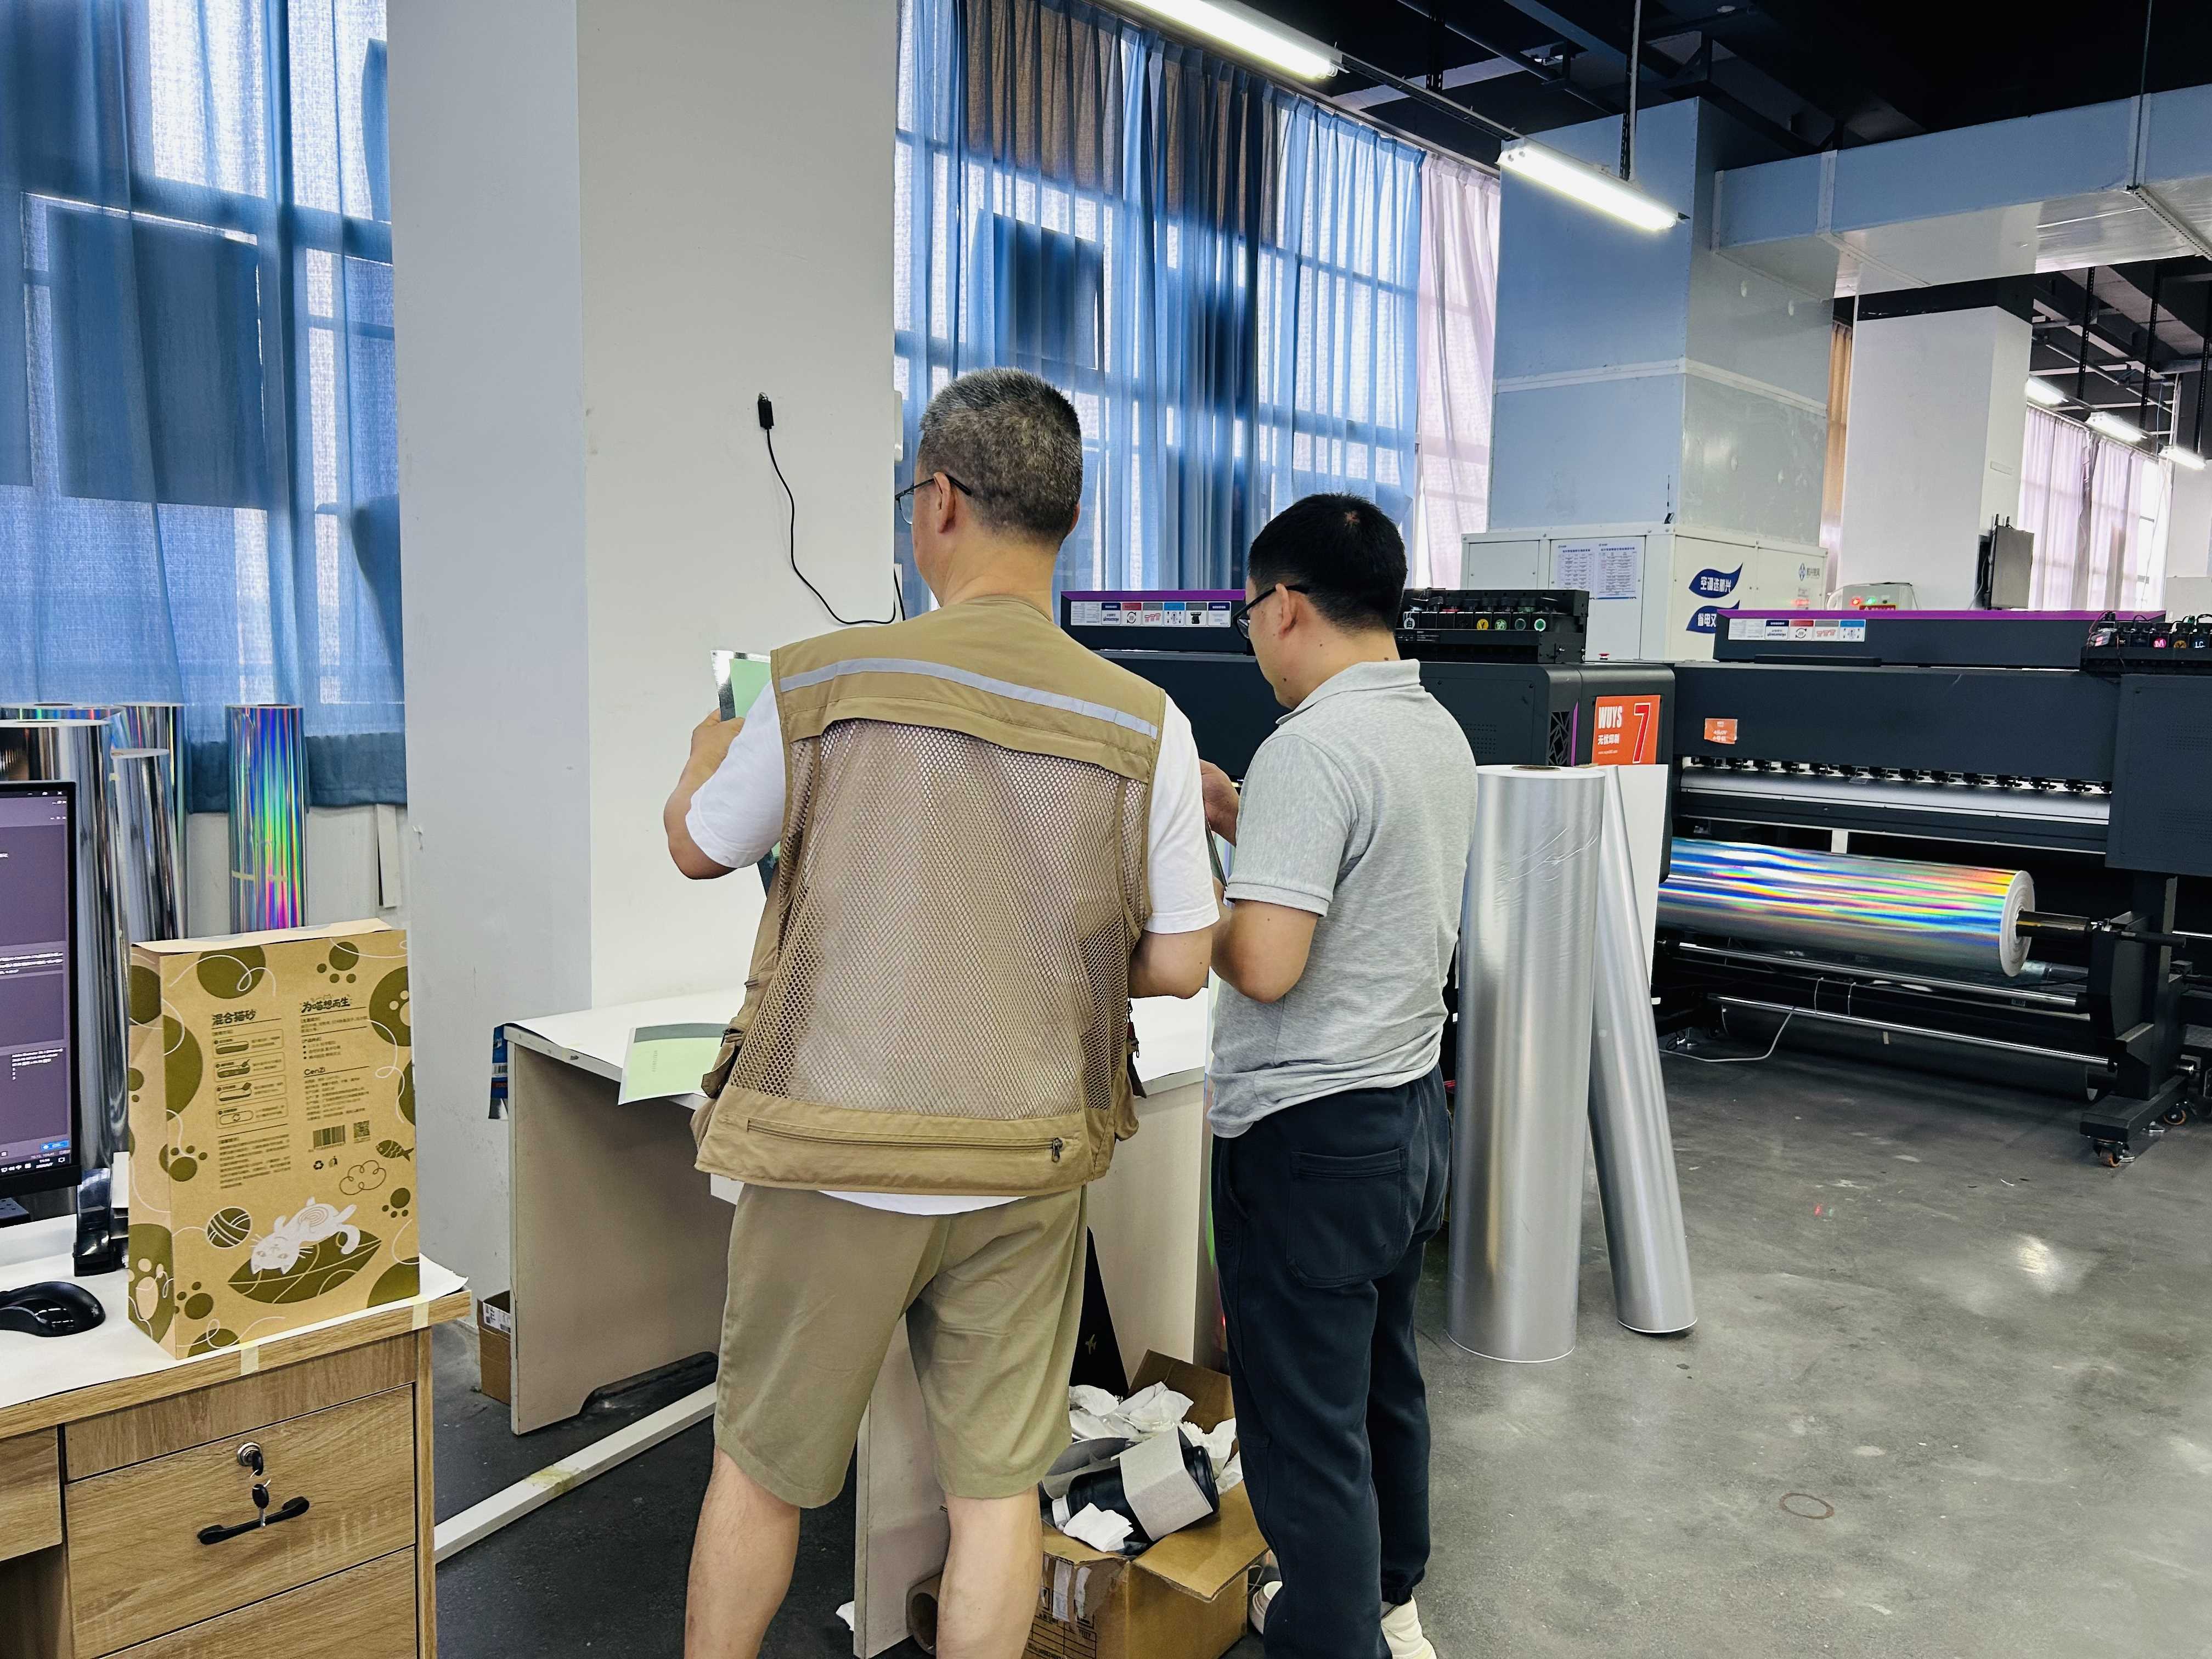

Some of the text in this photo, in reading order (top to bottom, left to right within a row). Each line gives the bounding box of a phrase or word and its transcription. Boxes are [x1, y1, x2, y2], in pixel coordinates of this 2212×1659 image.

[1700, 576, 1731, 593] 空调选航兴
[1697, 612, 1717, 628] 省电又
[2155, 639, 2165, 648] M
[1598, 706, 1623, 729] WUYS
[1632, 702, 1651, 764] 7
[301, 997, 350, 1013] 为喵想而生
[212, 1009, 256, 1026] 混合猫砂
